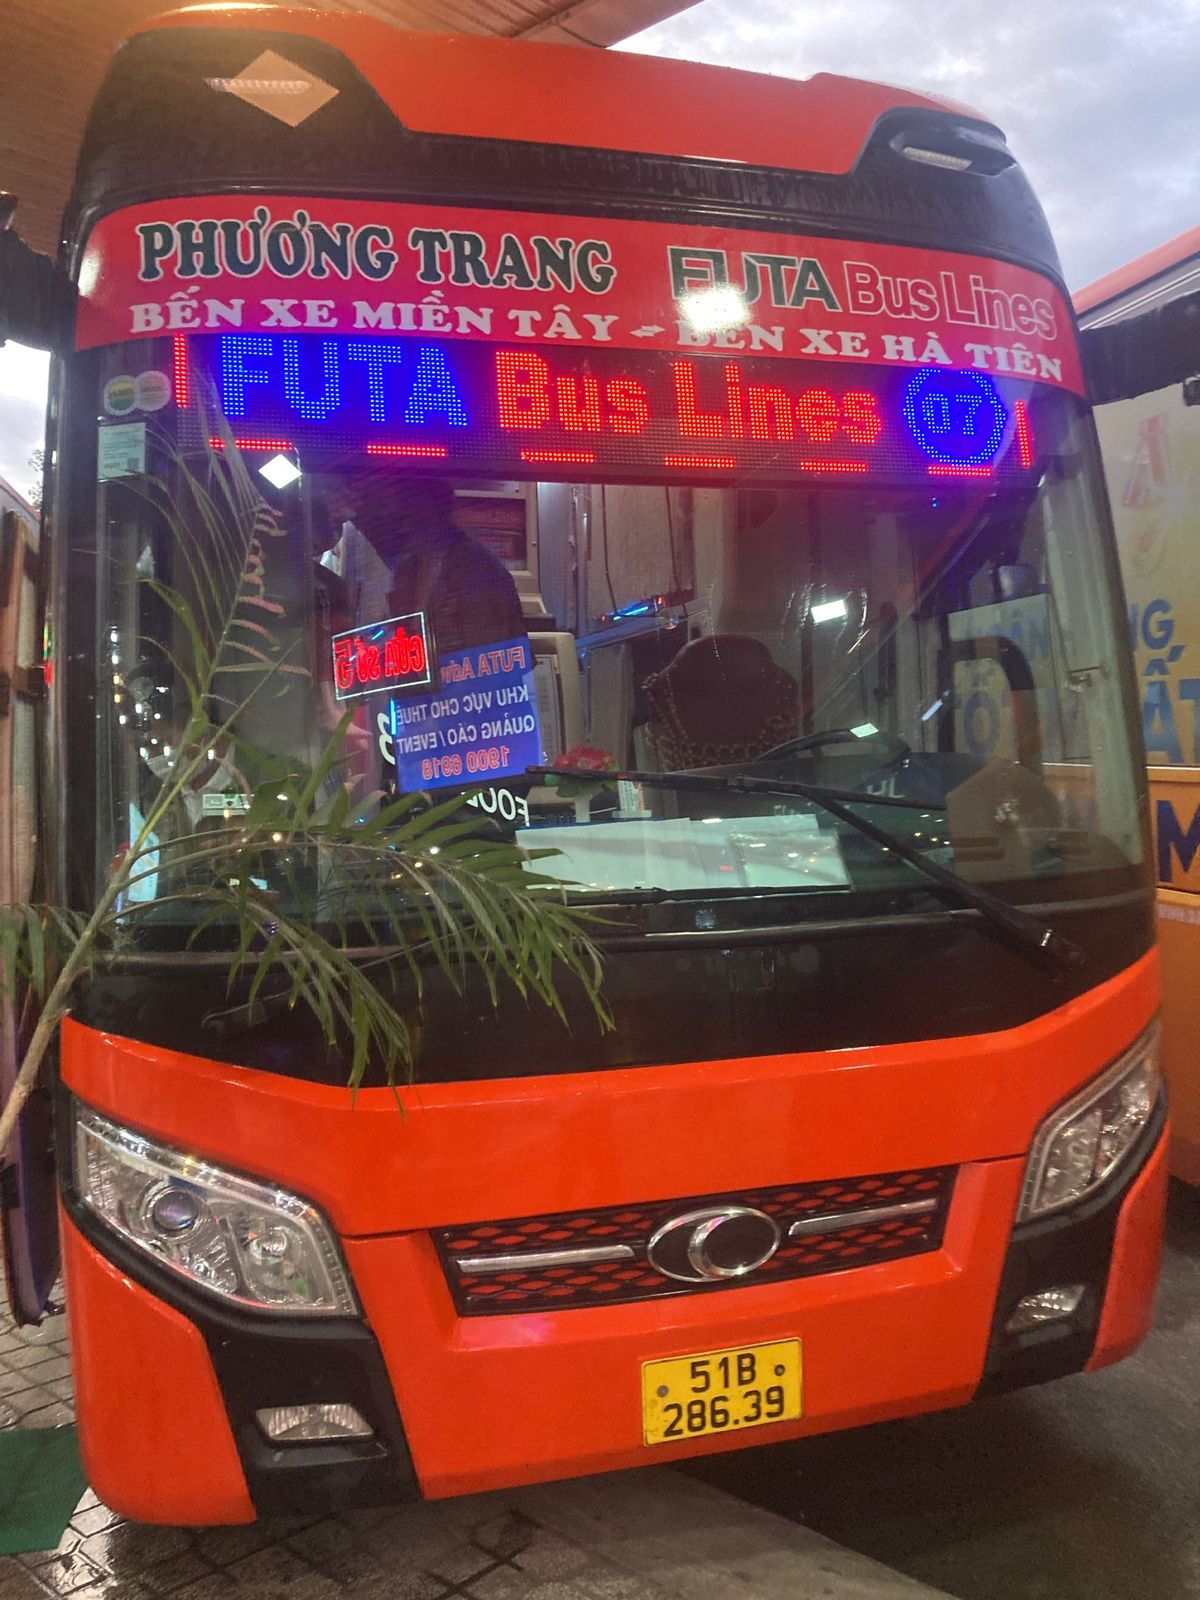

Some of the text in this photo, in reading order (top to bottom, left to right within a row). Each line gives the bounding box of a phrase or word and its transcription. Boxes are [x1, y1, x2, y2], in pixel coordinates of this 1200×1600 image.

[135, 206, 617, 294] PHƯƠNG TRANG
[667, 246, 843, 312] FUTA
[130, 286, 619, 341] BẾN XE MIỀN TÂY
[800, 328, 869, 358] XE
[881, 332, 953, 364] HÀ
[964, 342, 1063, 381] TIÊN
[221, 335, 882, 443] FUTA Bus Lines
[921, 393, 983, 435] 07
[690, 1352, 756, 1393] 51B
[663, 1385, 785, 1438] 286.39
